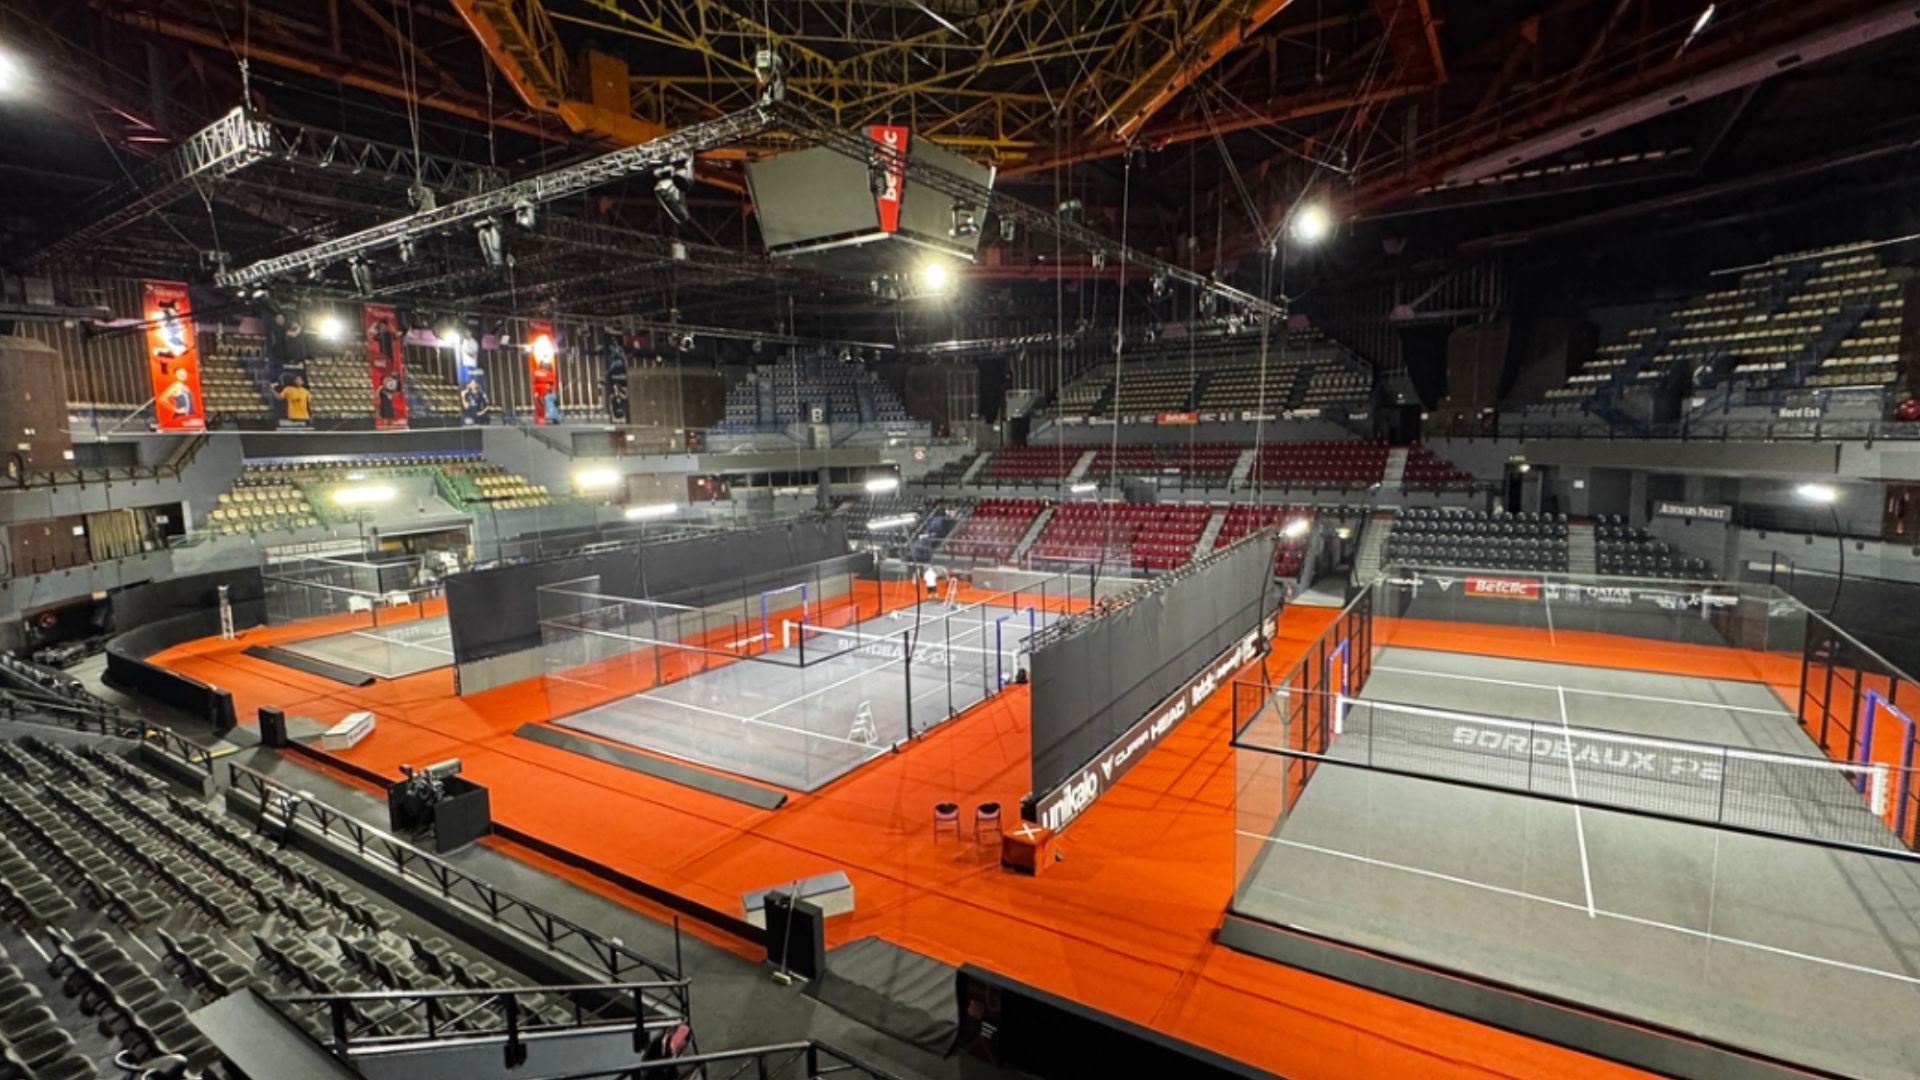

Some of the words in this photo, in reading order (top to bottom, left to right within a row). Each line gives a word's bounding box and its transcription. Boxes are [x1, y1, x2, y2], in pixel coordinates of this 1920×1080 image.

[811, 408, 823, 423] B
[1042, 771, 1098, 830] unikalo
[1150, 696, 1186, 740] HEAD
[1452, 726, 1656, 772] BORDEAUX
